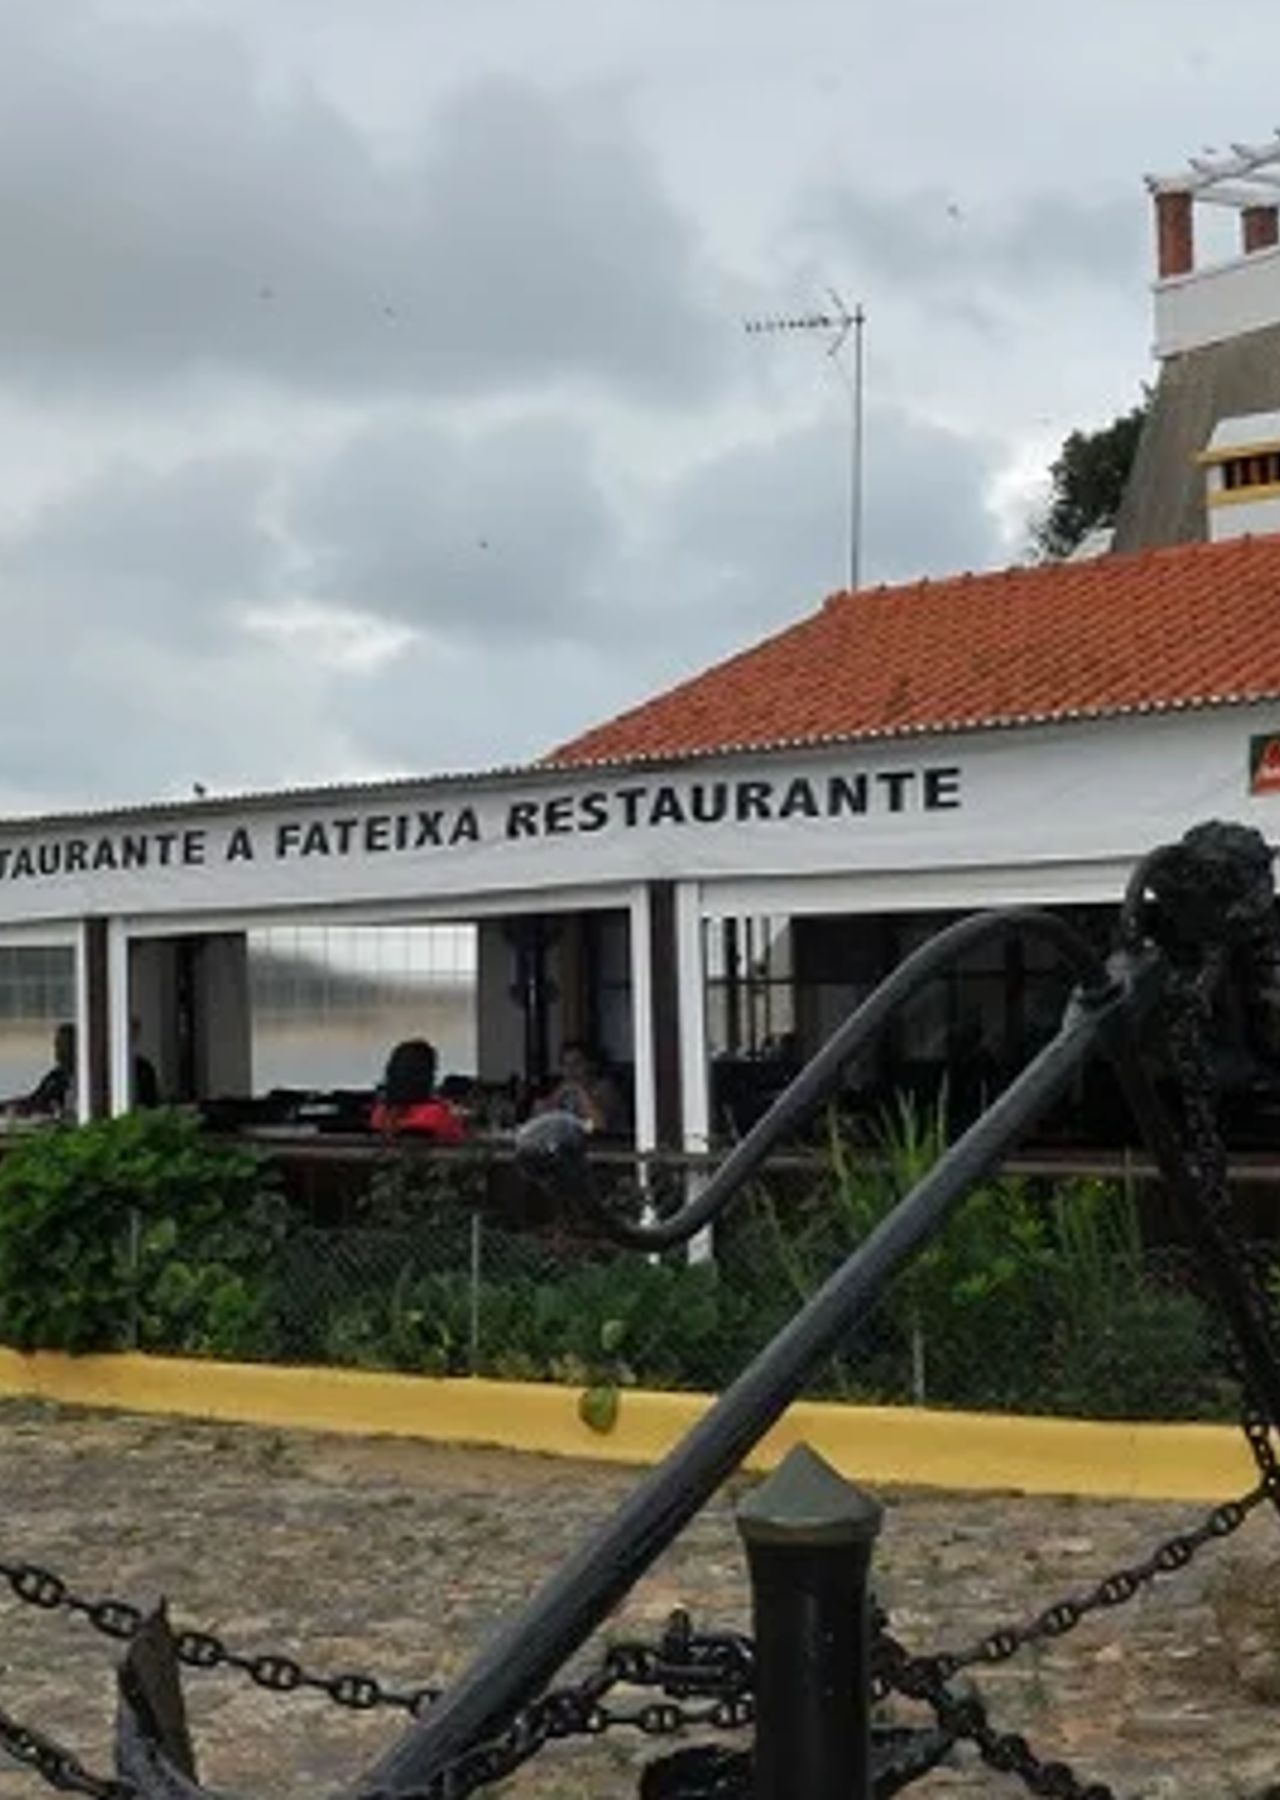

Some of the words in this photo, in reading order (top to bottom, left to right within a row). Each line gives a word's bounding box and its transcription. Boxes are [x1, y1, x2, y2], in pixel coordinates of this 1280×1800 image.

[227, 827, 254, 860] A
[277, 810, 481, 858] FATEIXA
[506, 766, 961, 840] RESTAURANTE
